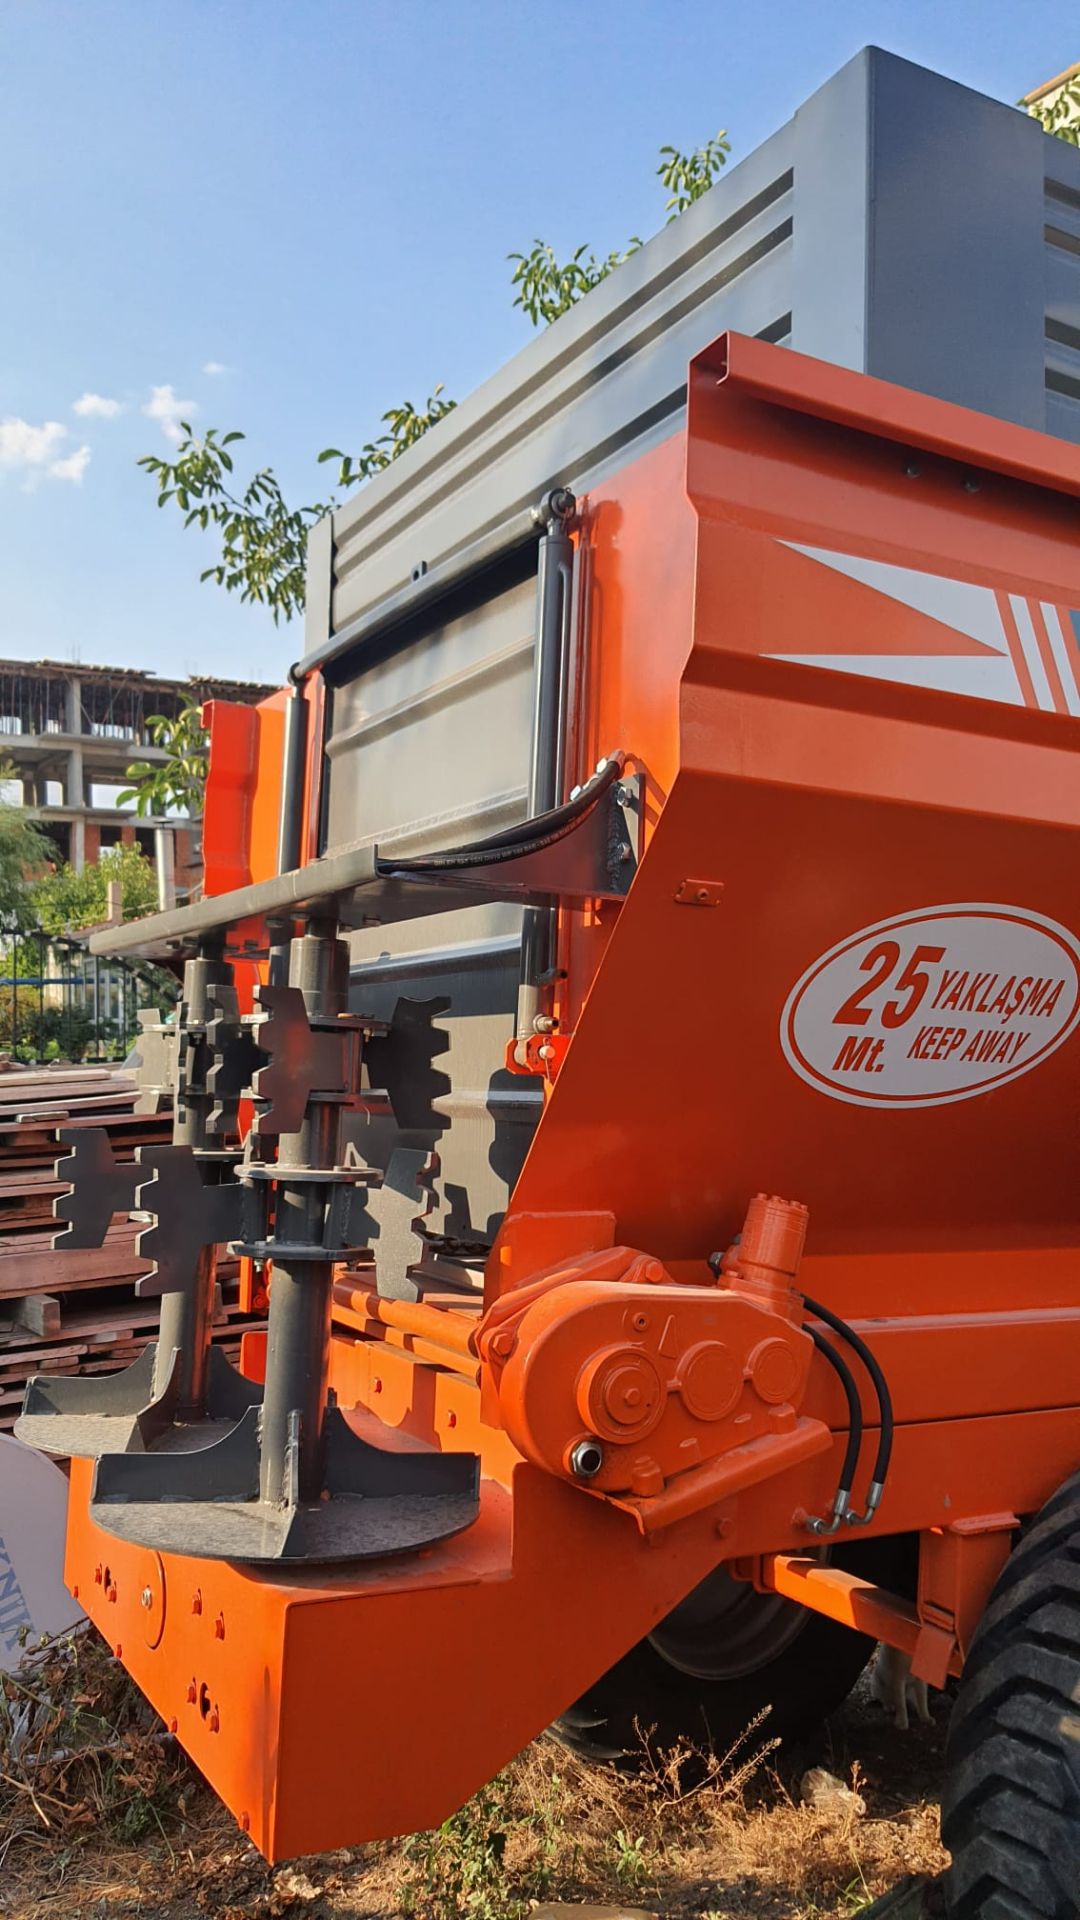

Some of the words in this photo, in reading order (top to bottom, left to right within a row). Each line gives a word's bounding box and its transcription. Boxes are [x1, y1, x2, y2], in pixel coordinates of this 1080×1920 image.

[832, 941, 946, 1029] 25
[931, 970, 1065, 1024] YAKLAŞMA
[832, 1036, 885, 1072] Mt.
[907, 1026, 968, 1061] KEEP
[959, 1029, 1031, 1063] AWAY
